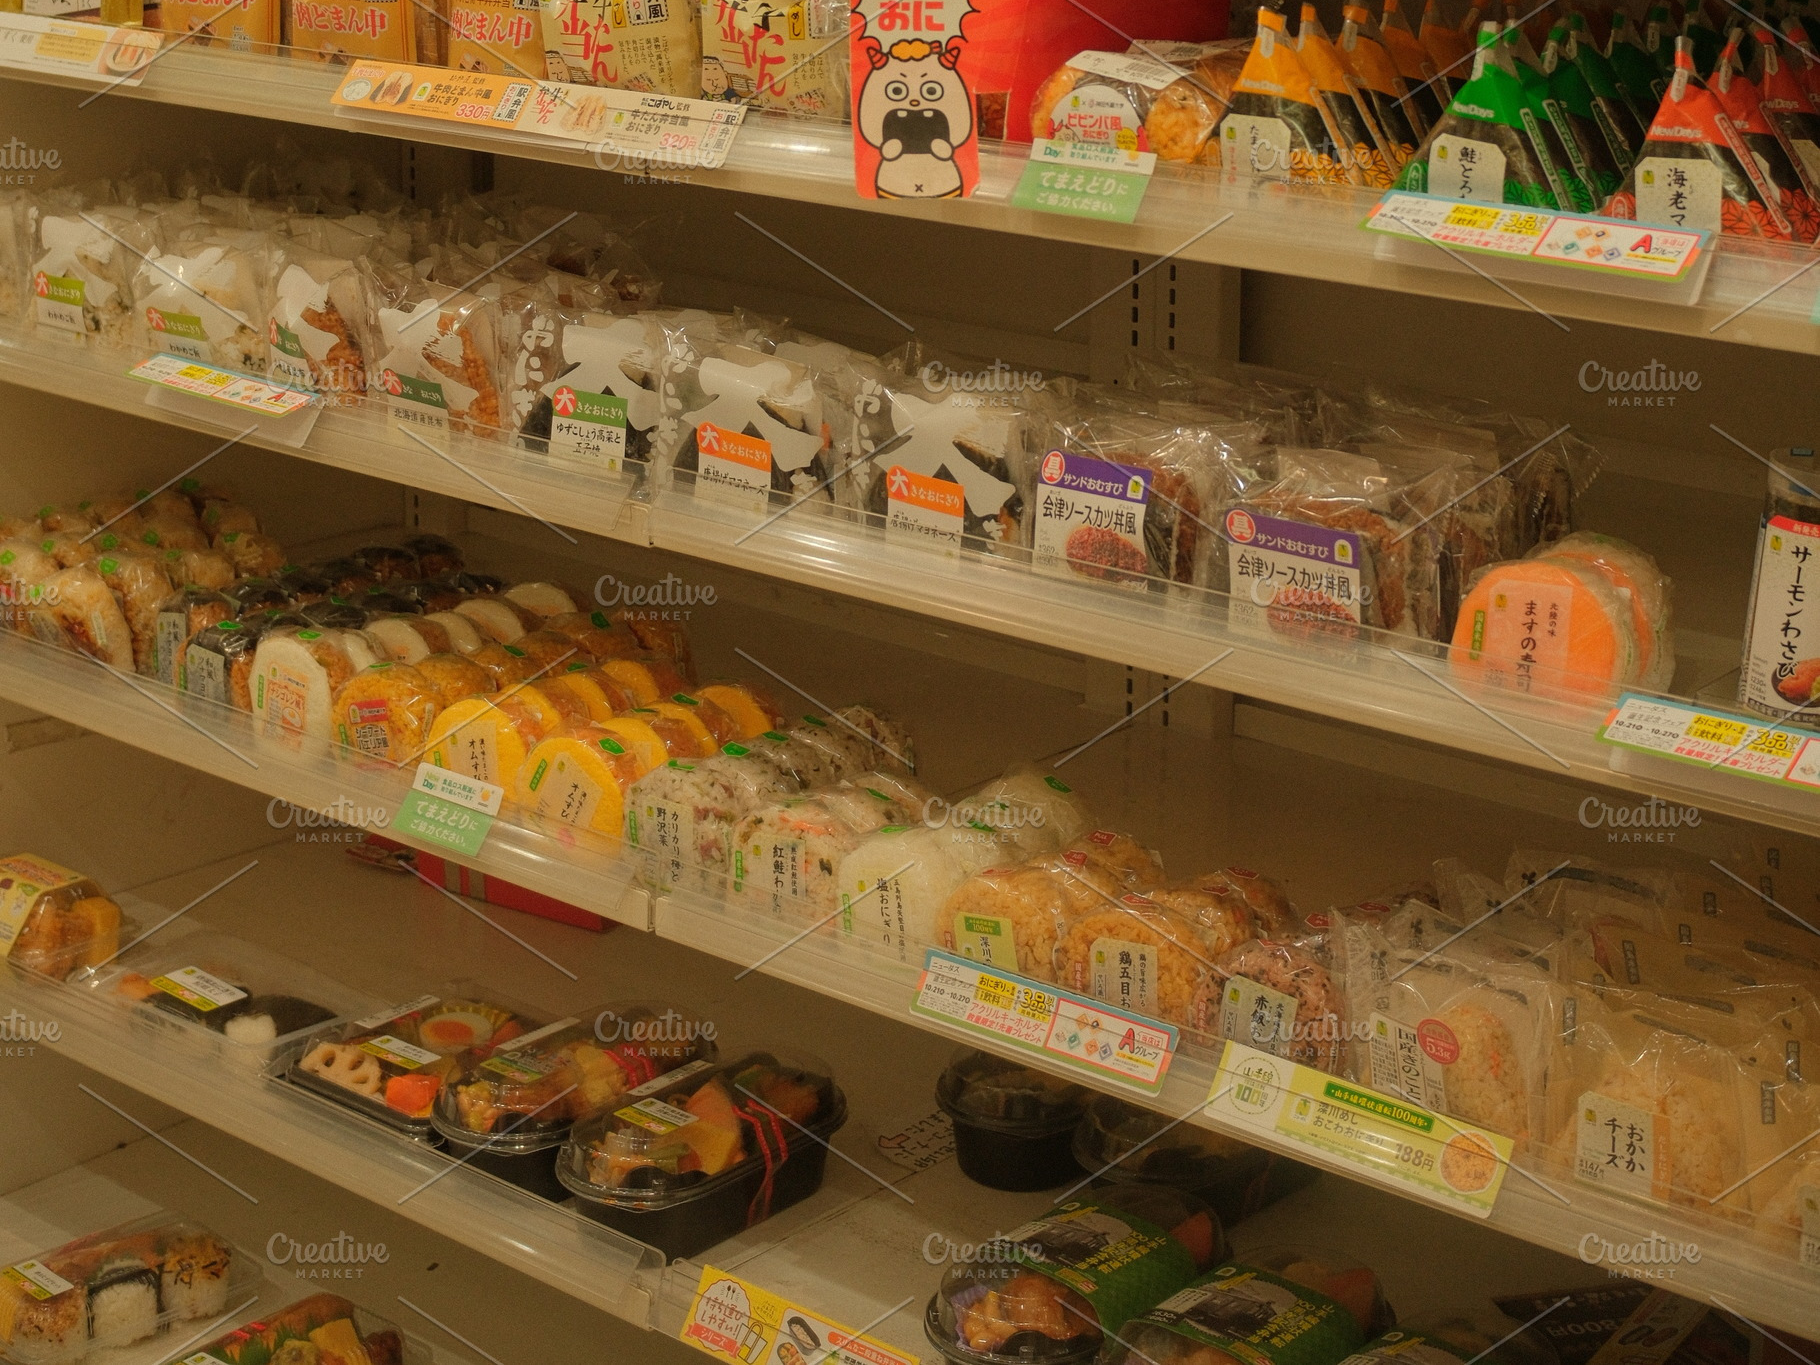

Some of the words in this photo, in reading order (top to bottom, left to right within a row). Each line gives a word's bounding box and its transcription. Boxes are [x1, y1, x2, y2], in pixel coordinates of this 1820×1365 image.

[877, 0, 946, 33] おに
[427, 94, 459, 107] おにぎり
[456, 103, 491, 120] 330円
[505, 82, 532, 122] 駅弁風
[1452, 102, 1495, 119] NewDays
[625, 121, 662, 135] おにぎり
[630, 108, 690, 128] 牛たん弁当風
[1067, 112, 1123, 131] ビビンバ風
[659, 132, 698, 151] 320円
[713, 112, 738, 153] 駅弁風
[1652, 125, 1703, 140] NewDays
[1040, 169, 1129, 196] てまえどりに
[1666, 167, 1687, 226] 海老マ
[1630, 234, 1654, 253] A
[148, 307, 164, 329] 大
[385, 370, 401, 393] 大
[556, 387, 576, 412] 大
[576, 401, 625, 421] きなおにぎり
[555, 421, 622, 445] ゆずこしょう高菜と
[700, 423, 719, 451] 大
[720, 442, 769, 465] きなおにぎり
[1043, 453, 1063, 480] 具
[1063, 472, 1123, 496] サンドおむすび
[889, 471, 909, 497] 大
[910, 483, 961, 510] きなおにぎり
[1042, 497, 1137, 536] 会津ソースカツ丼風
[1229, 514, 1254, 539] 具
[1256, 532, 1330, 559] サンドおむすび
[1236, 555, 1352, 602] 会津ソースカツ丼風
[1776, 545, 1813, 678] サーモンわさび
[1693, 716, 1733, 731] おにぎり
[1700, 729, 1724, 741] 飲料
[1679, 737, 1788, 767] アクリルキーホルダー
[1753, 727, 1789, 750] 3品
[415, 798, 479, 830] てまえどりに
[655, 806, 670, 848] 野沢菜
[978, 974, 1007, 992] おにぎり
[1118, 950, 1133, 1008] 鶏五目お
[982, 991, 1000, 1005] 飲料
[1021, 988, 1047, 1013] 3品
[966, 1013, 1042, 1044] 数量限定!先着プレゼント
[970, 1002, 1046, 1034] アクリルキーホルダー
[1118, 1027, 1136, 1054] A
[1135, 1045, 1160, 1061] グループ
[1316, 1103, 1359, 1125] 深川めし
[1394, 1141, 1435, 1171] 188円
[1604, 1118, 1625, 1168] チーズ
[1625, 1122, 1645, 1173] おかか
[705, 1295, 746, 1321] 持ち運び
[700, 1310, 739, 1337] しやすい!
[700, 1328, 728, 1347] シリーズ
